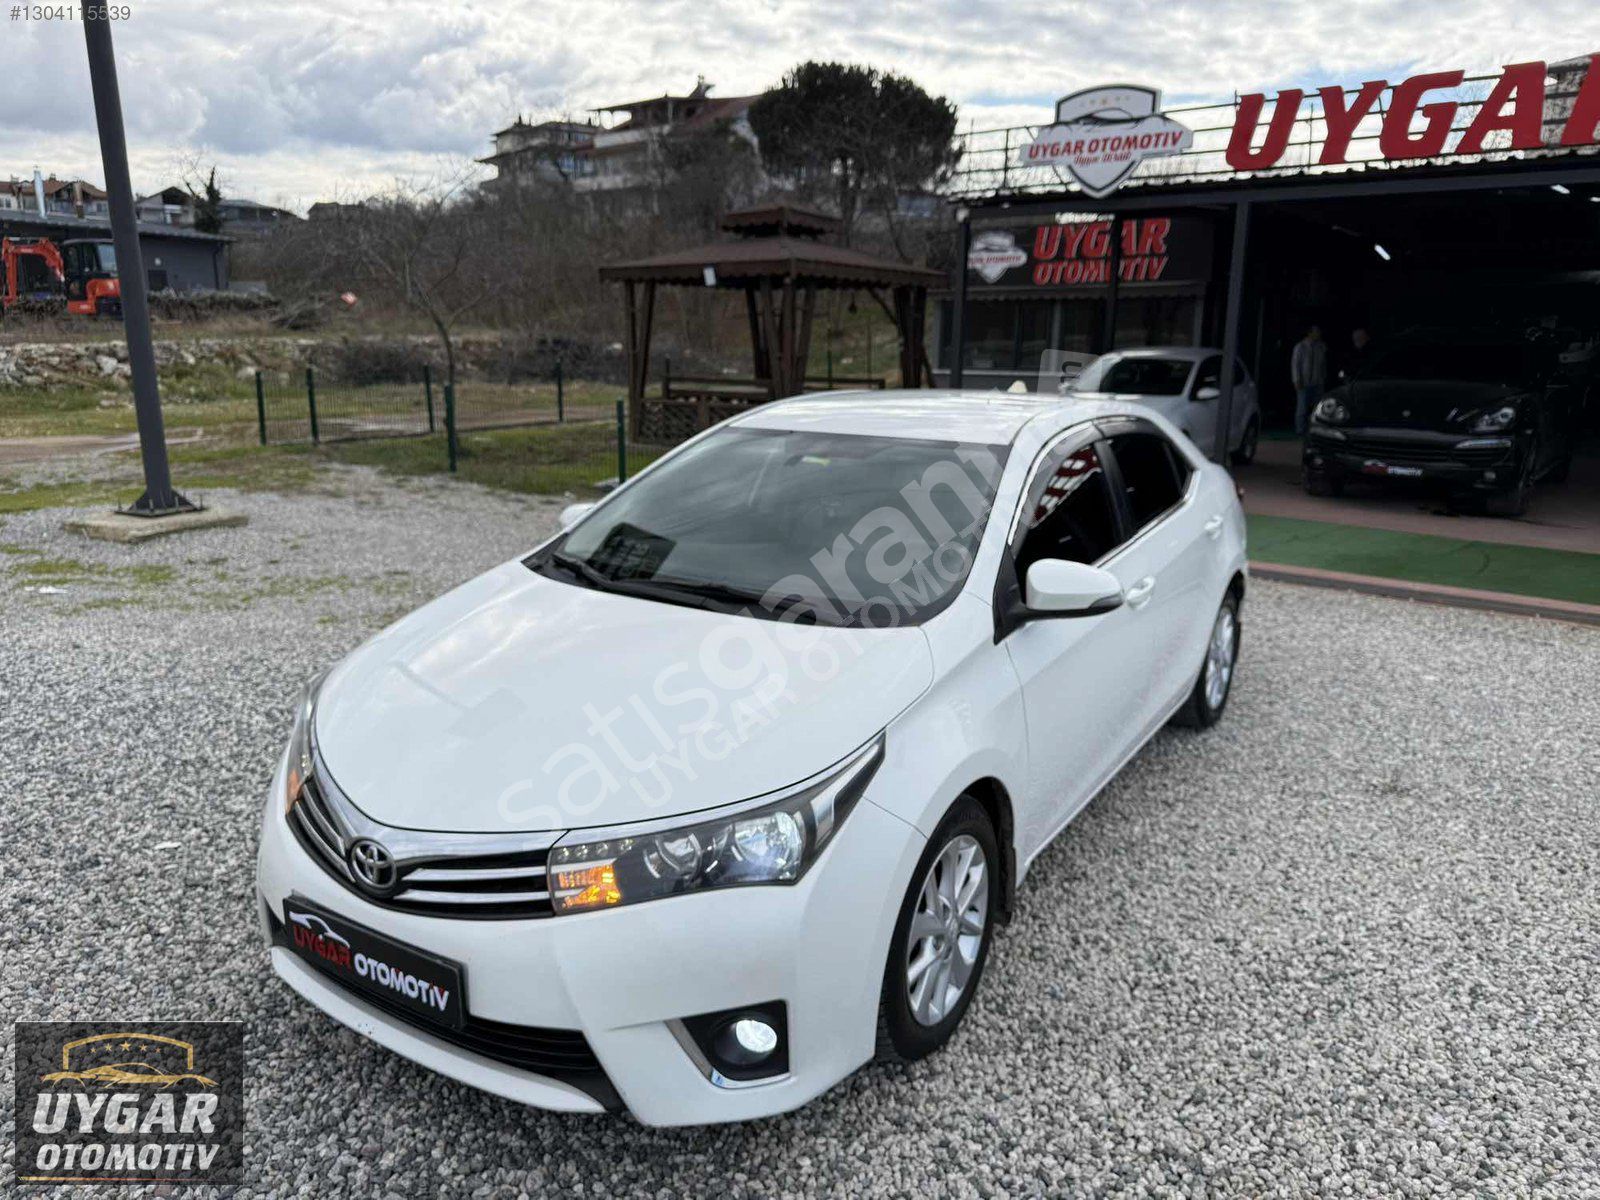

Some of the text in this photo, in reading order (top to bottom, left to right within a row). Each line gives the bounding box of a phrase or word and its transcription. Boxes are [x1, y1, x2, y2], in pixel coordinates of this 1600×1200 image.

[1028, 131, 1183, 159] UYGAR OTOMOTIV
[1033, 217, 1171, 260] UYGAR
[1032, 255, 1169, 285] OTOMTIV
[293, 925, 352, 970] UYGAR
